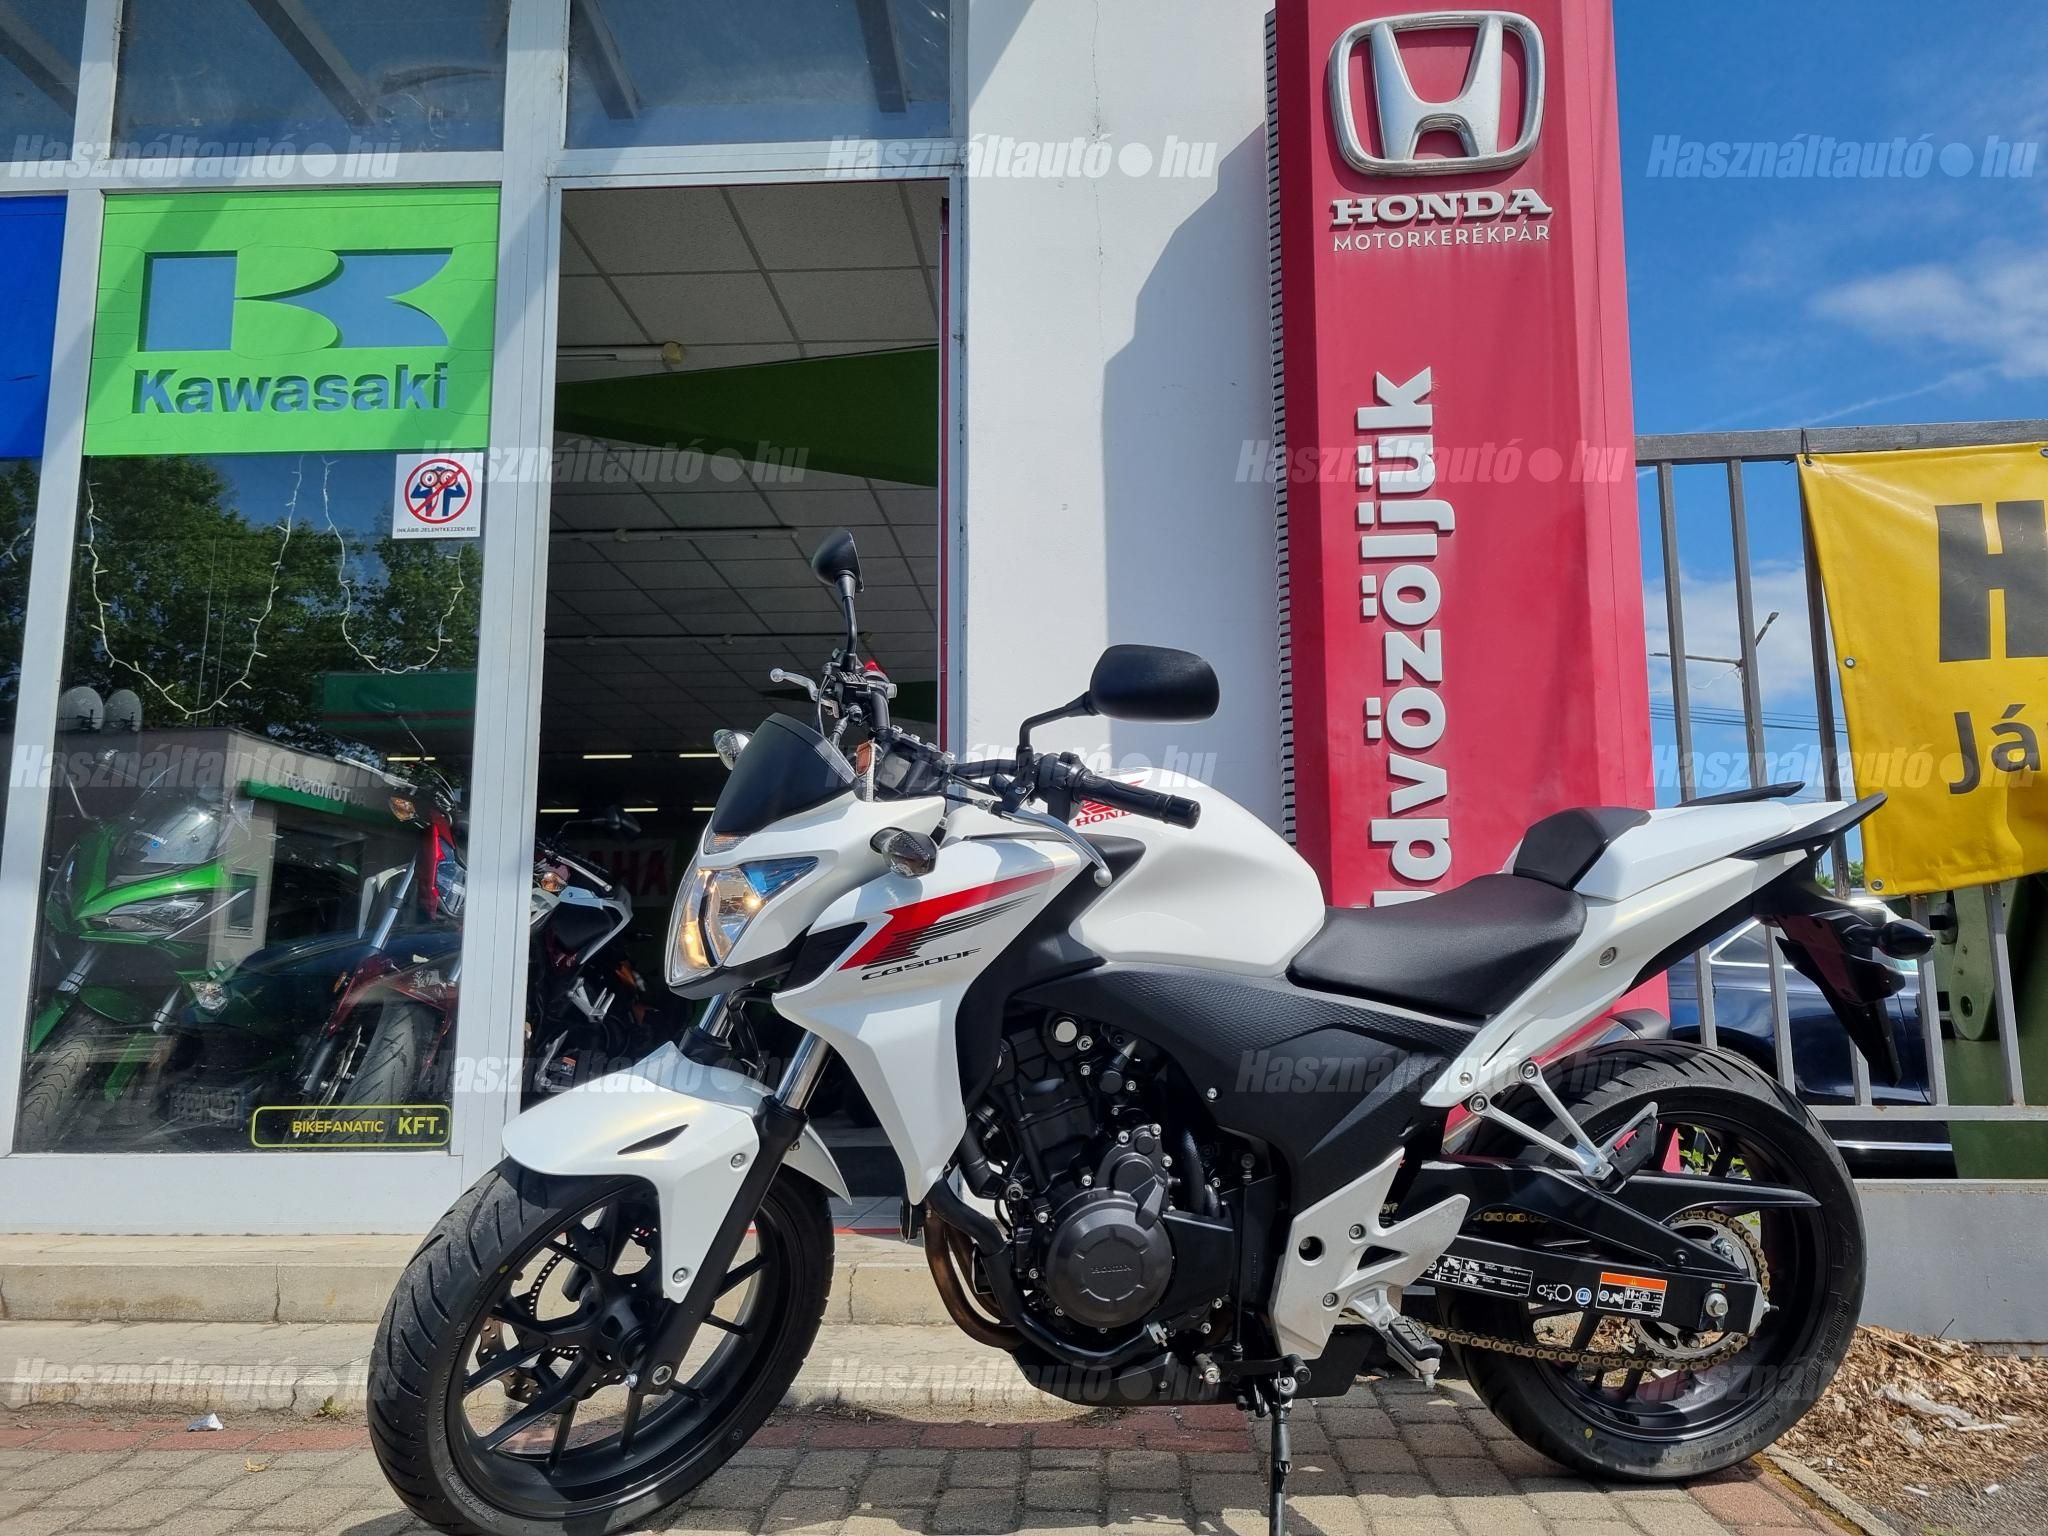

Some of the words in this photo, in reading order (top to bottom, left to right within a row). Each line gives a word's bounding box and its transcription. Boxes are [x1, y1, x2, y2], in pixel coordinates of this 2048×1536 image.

[1332, 188, 1553, 225] HONDA
[1333, 220, 1550, 252] MOTORKERÉKPÁR
[132, 362, 448, 414] Kawasaki
[1949, 703, 2042, 795] Já
[1074, 809, 1134, 827] HON
[292, 1121, 385, 1133] BIKEFANATIC
[398, 1116, 445, 1135] KFT.
